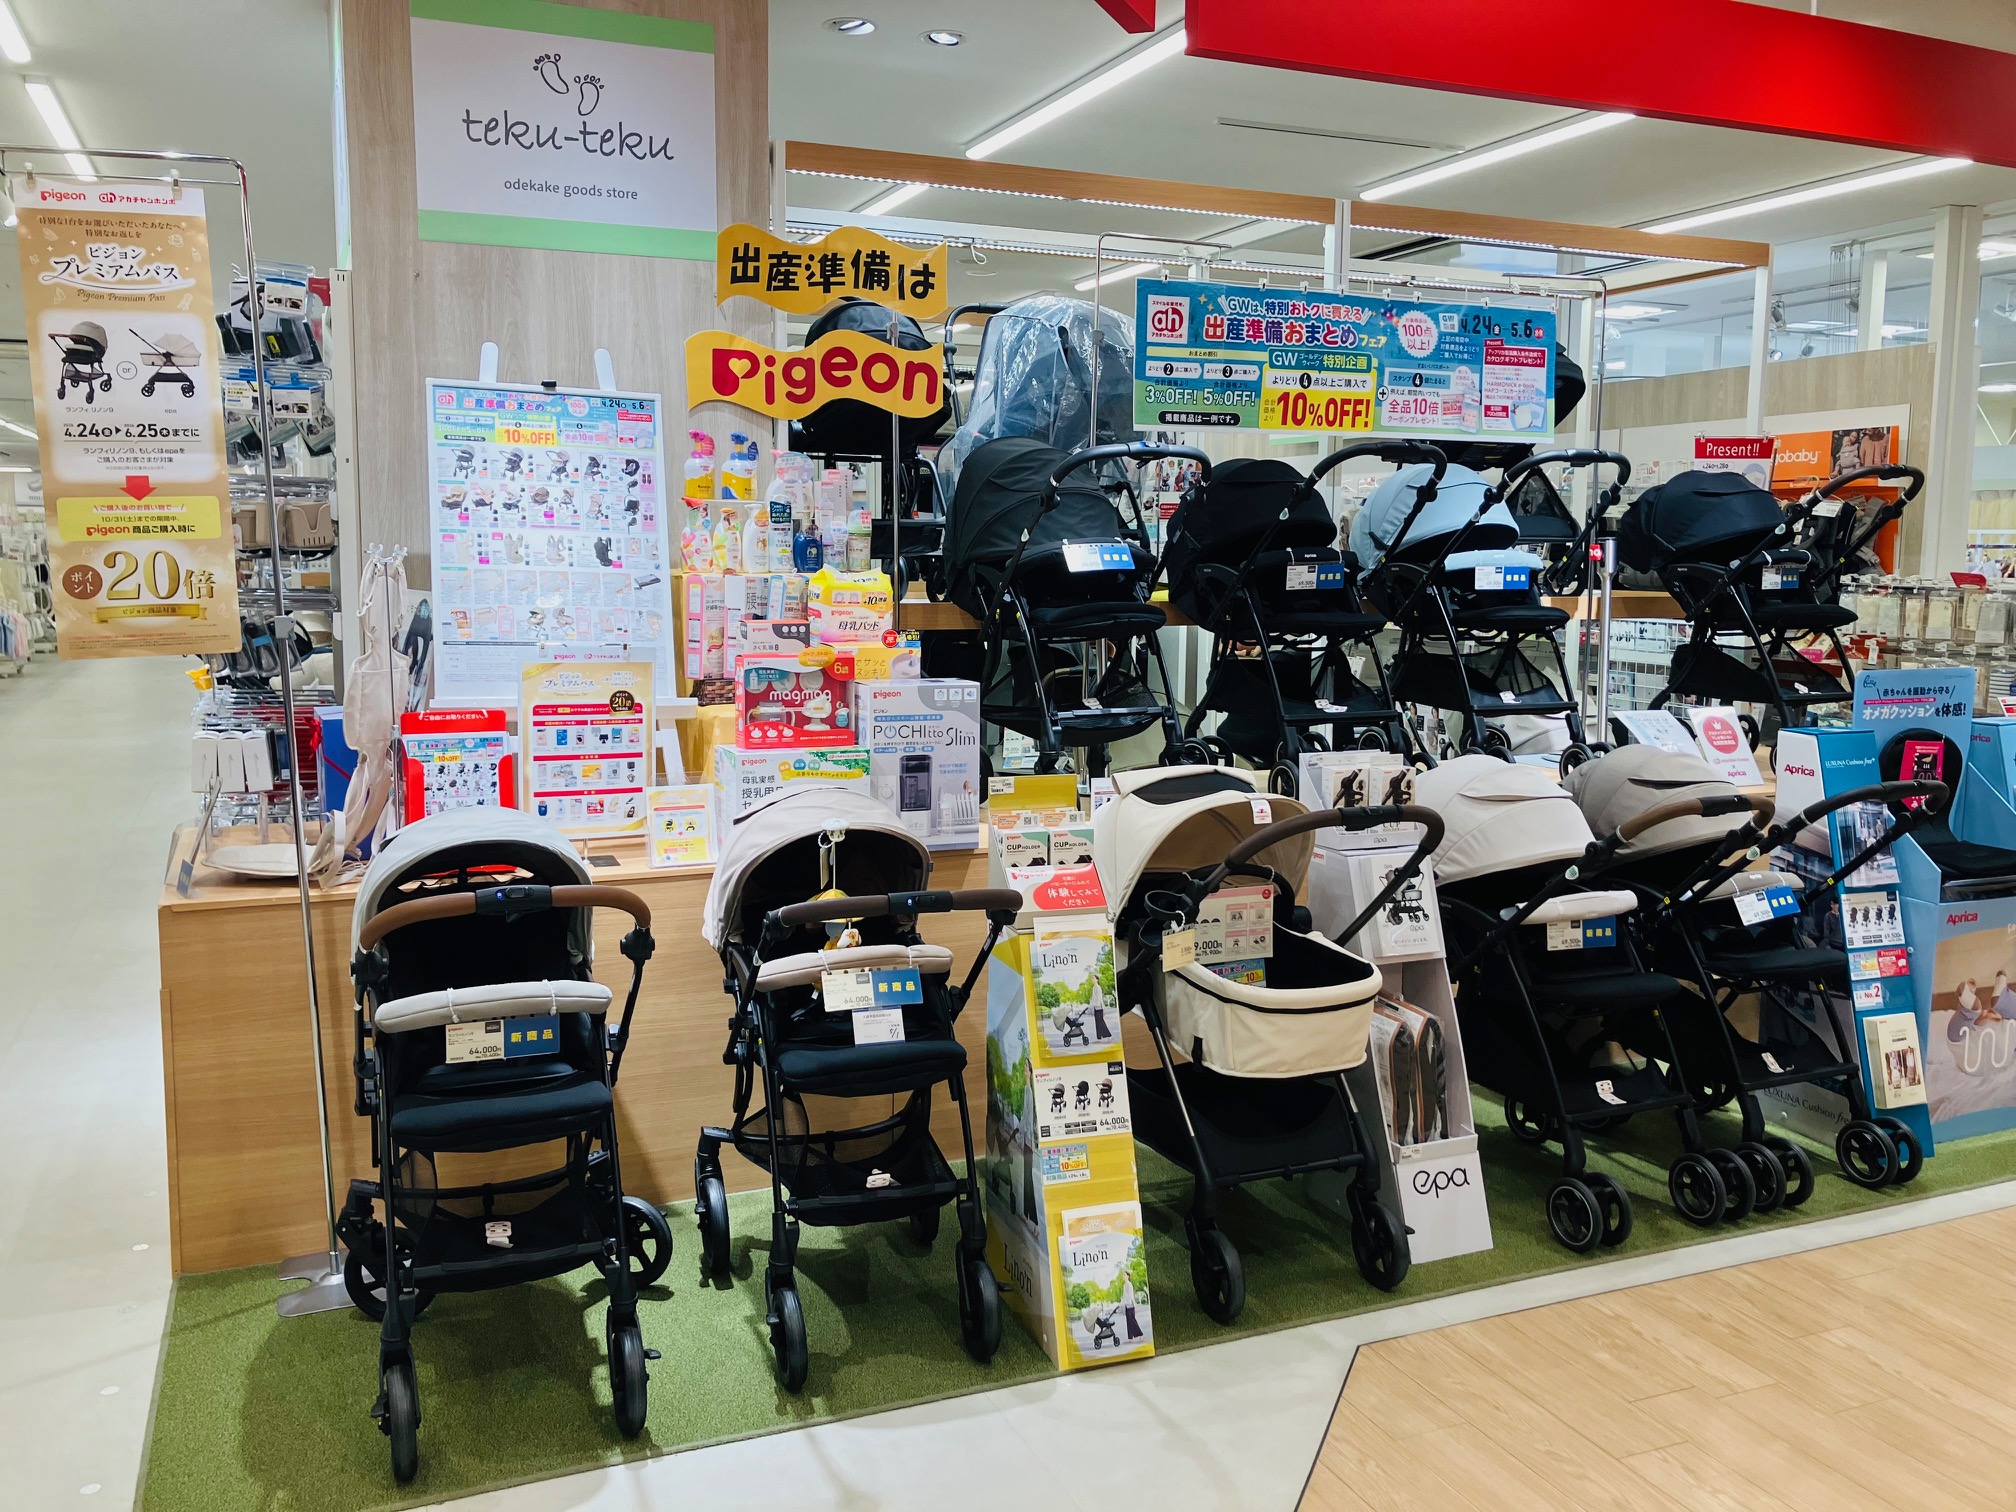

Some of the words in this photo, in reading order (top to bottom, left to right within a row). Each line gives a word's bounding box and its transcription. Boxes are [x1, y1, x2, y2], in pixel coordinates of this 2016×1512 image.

[462, 108, 675, 161] teku-teku
[504, 178, 560, 194] odekake
[563, 183, 603, 198] goods
[606, 187, 638, 200] store
[85, 229, 142, 239] 特別なお返しを
[89, 246, 142, 260] ピジョン
[53, 258, 178, 280] プレミアムパス
[729, 242, 936, 301] 出産準備は
[77, 289, 105, 303] Pigeon
[108, 293, 146, 303] Premium
[148, 293, 166, 303] Pass
[1228, 297, 1362, 321] GWは、特別おトクに買える
[1272, 351, 1298, 366] GW
[1323, 354, 1367, 369] 特別企画
[121, 366, 132, 374] or
[1145, 385, 1198, 405] 3%OFF!
[1203, 388, 1256, 407] 5%OFF!
[1277, 391, 1371, 428] 10%OFF!
[1388, 398, 1439, 416] 全品10倍
[504, 429, 555, 445] 10%OFF!
[1706, 443, 1759, 456] Present!!
[96, 456, 174, 464] ご購入のお客さまが対象
[132, 525, 196, 535] 商品ご購入時に
[103, 550, 217, 600] 20倍
[838, 621, 879, 631] 母乳パッド
[769, 689, 832, 704] magmag
[873, 690, 901, 699] pigeon
[1862, 702, 1967, 720] オメガクッションを体感!
[945, 727, 976, 746] Slim
[1971, 734, 1991, 743] prica
[741, 758, 767, 766] pigeon
[1784, 764, 1815, 777] Aprica
[742, 775, 775, 784] 母乳実感
[742, 787, 784, 799] 授乳用
[1047, 888, 1098, 898] 体験してみて
[1947, 911, 1978, 926] Aprica
[1043, 953, 1078, 968] Lino'n
[1801, 1100, 1836, 1119] Cushion
[1413, 1167, 1470, 1198] epa
[1073, 1250, 1108, 1267] Lino'n
